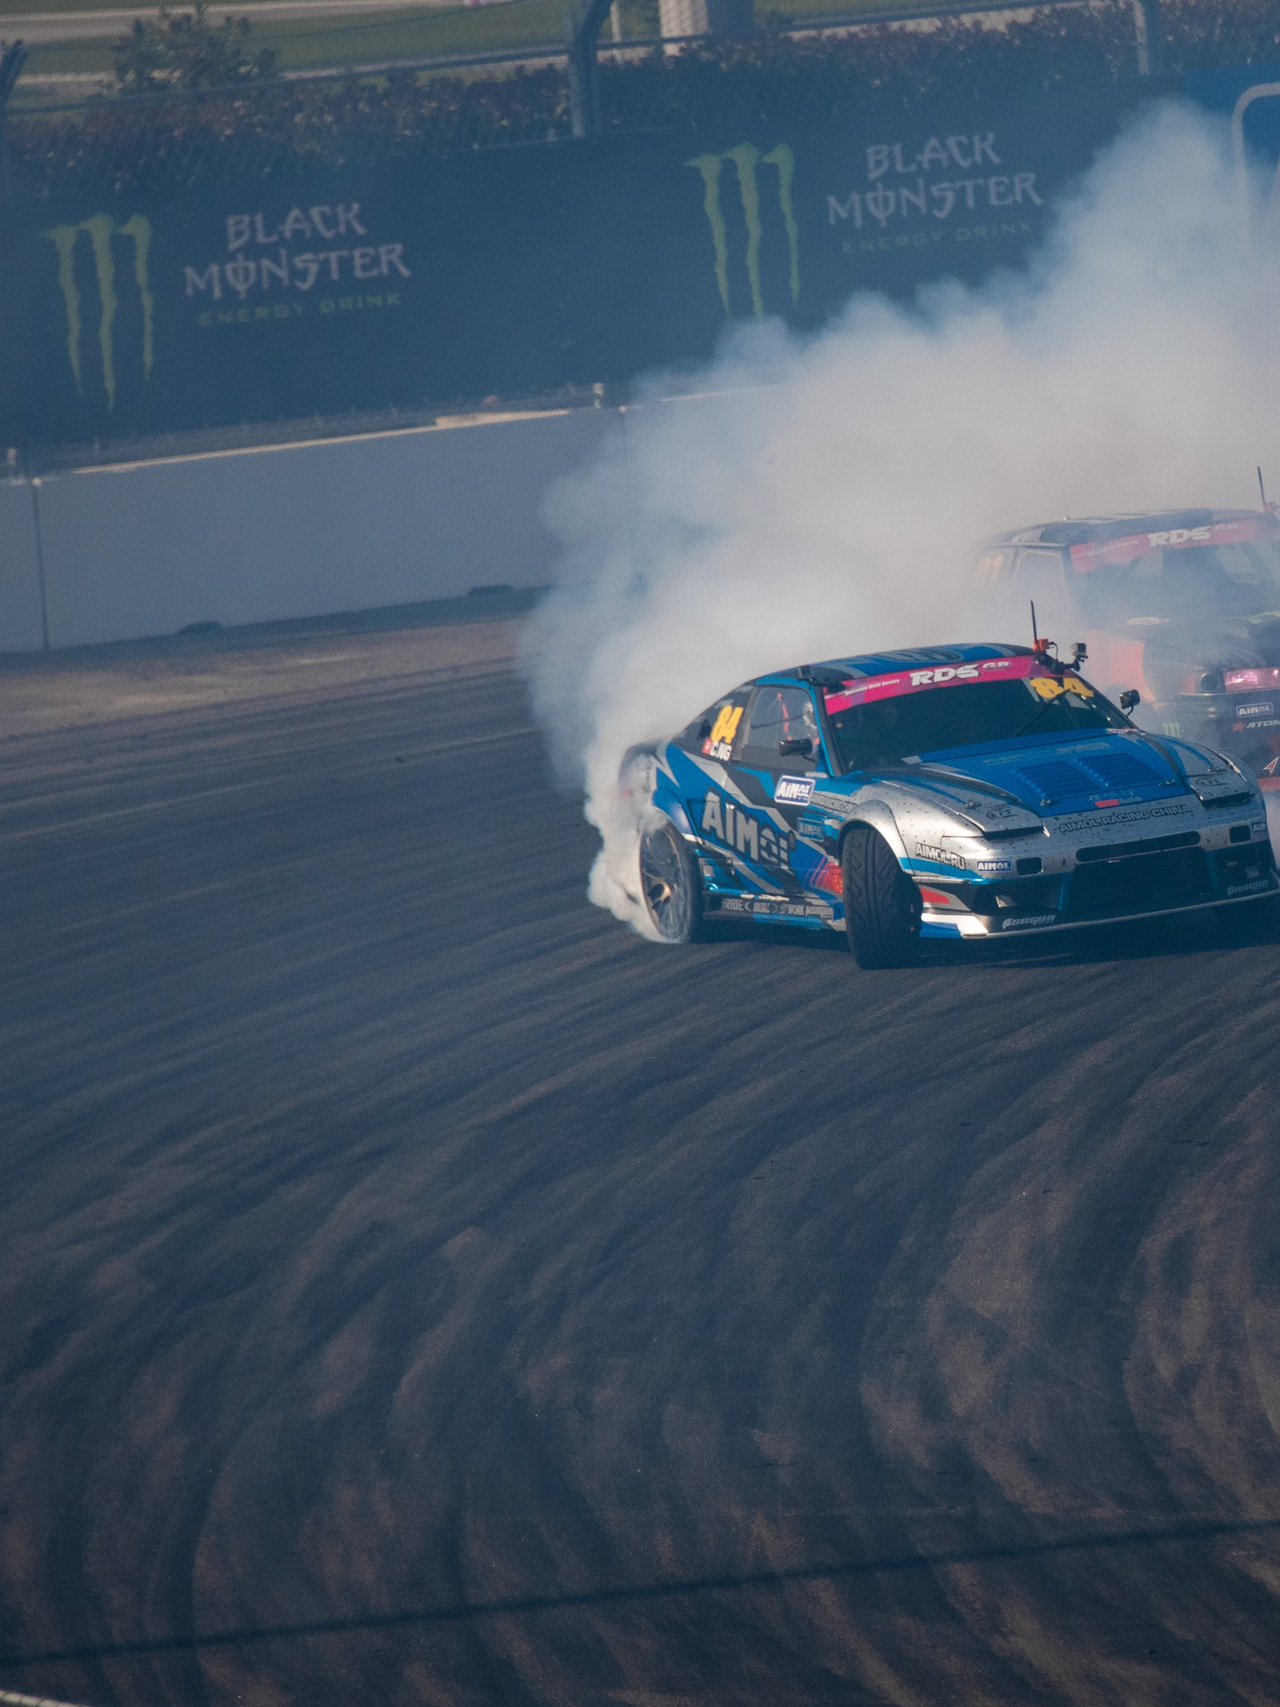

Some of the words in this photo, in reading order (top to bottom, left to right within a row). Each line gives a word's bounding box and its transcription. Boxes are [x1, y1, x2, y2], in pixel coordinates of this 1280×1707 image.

[865, 132, 1002, 181] BLACK
[226, 202, 367, 251] BLACK
[842, 231, 943, 256] ENERGY
[955, 220, 1032, 242] DRINK
[199, 303, 303, 326] ENERGY
[319, 292, 401, 314] DRINK
[1147, 526, 1212, 547] RDS
[910, 664, 981, 686] RDS
[1030, 677, 1094, 699] 84
[1239, 705, 1271, 716] AIMOL
[710, 704, 743, 745] 84
[777, 781, 811, 801] AIMOL
[1060, 818, 1102, 834] AIMOL
[1100, 810, 1151, 826] RACING
[1151, 803, 1194, 819] CHINA
[977, 861, 1011, 872] AIMOL
